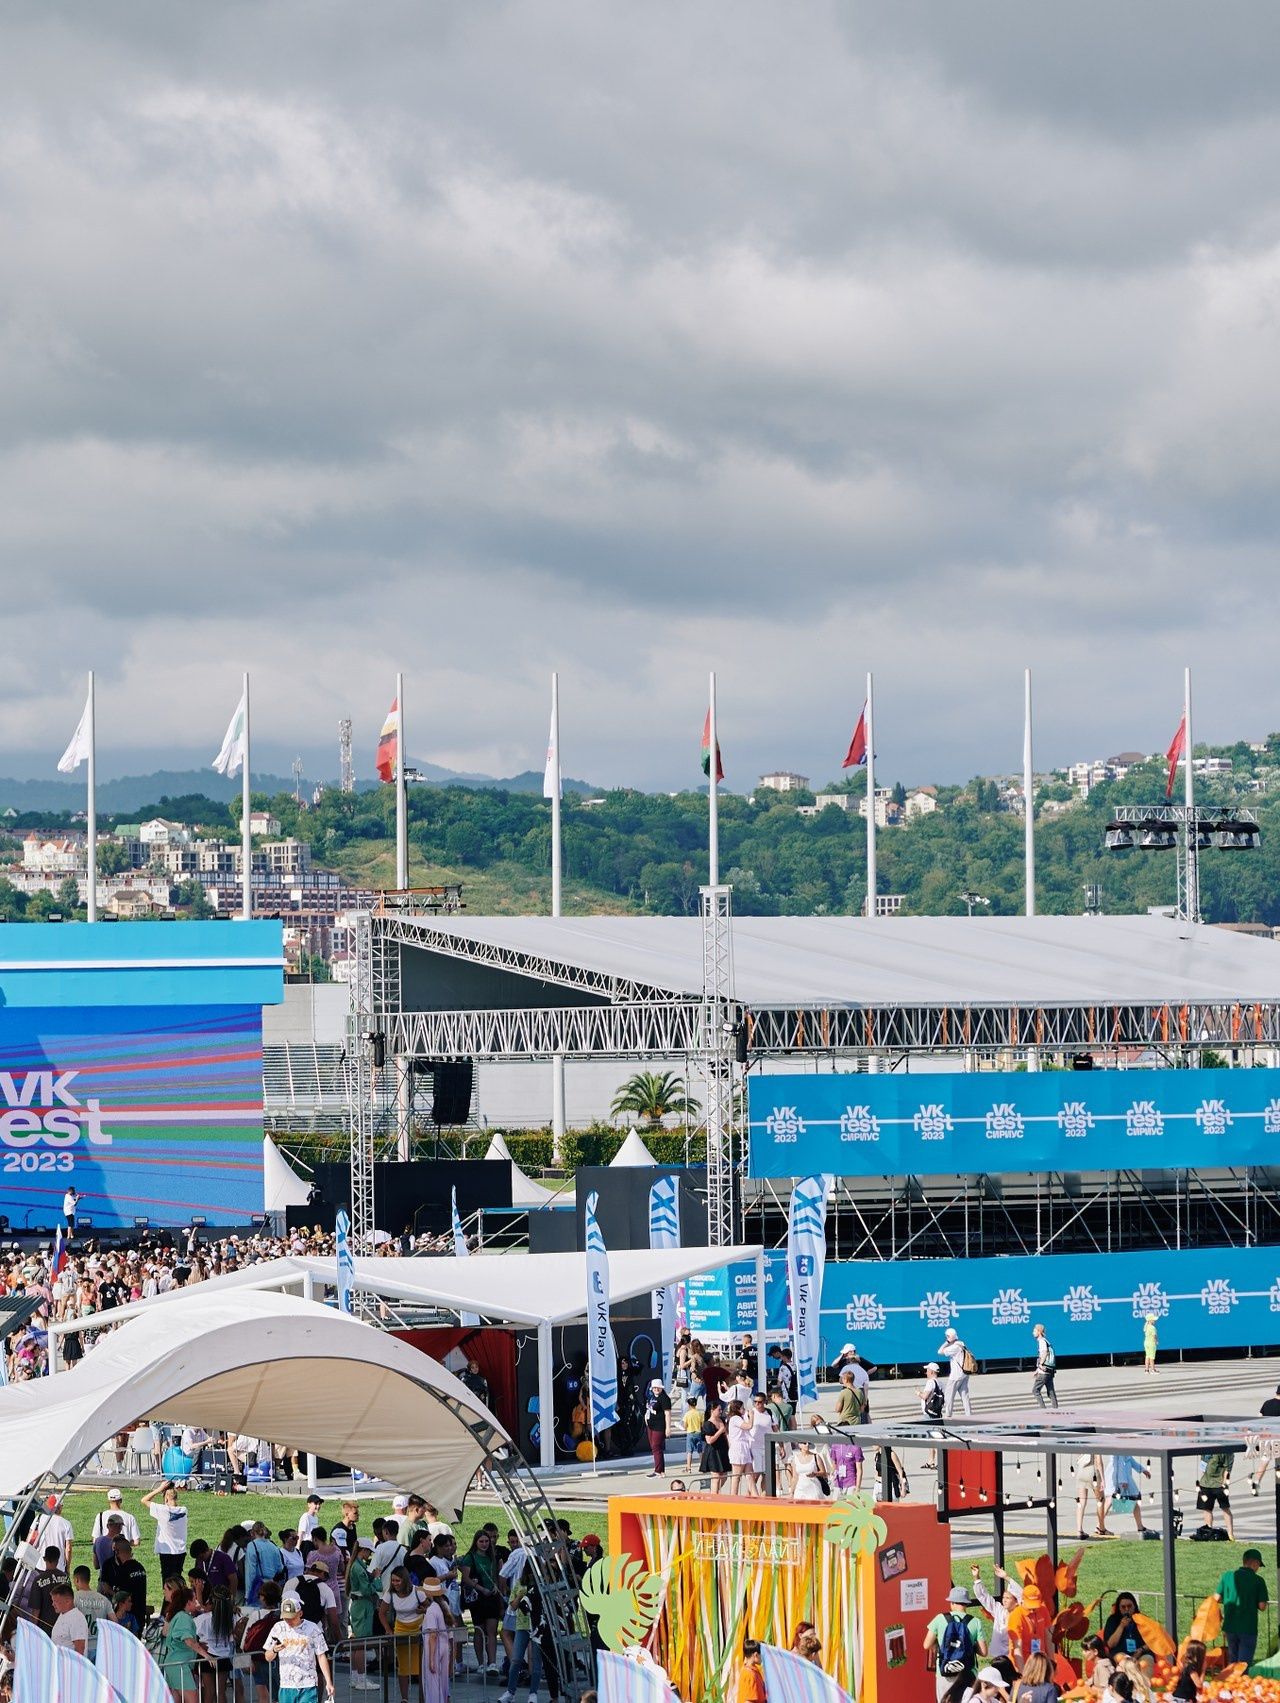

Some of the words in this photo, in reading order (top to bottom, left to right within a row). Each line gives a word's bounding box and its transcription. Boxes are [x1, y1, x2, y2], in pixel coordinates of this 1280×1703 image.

[772, 1106, 797, 1119] VK
[846, 1105, 871, 1118] VK
[920, 1104, 945, 1117] VK
[992, 1103, 1016, 1116] VK
[1064, 1102, 1086, 1115] VK
[1132, 1101, 1156, 1114] VK
[1202, 1100, 1225, 1113] VK
[840, 1114, 880, 1132] fest
[914, 1113, 954, 1131] fest
[986, 1112, 1024, 1130] fest
[1057, 1110, 1095, 1128] fest
[1126, 1109, 1164, 1127] fest
[1195, 1107, 1233, 1126] fest
[766, 1115, 806, 1134] fest
[1203, 1125, 1226, 1135] 2023
[840, 1132, 880, 1142] СИРИУС
[921, 1131, 945, 1140] 2023
[985, 1130, 1024, 1139] СИРИУС
[1065, 1128, 1087, 1137] 2023
[1126, 1127, 1164, 1136] СИРИУС
[774, 1134, 797, 1143] 2023
[3, 1151, 75, 1173] 2023
[1069, 1285, 1093, 1298] VK
[1138, 1282, 1161, 1295] VK
[1207, 1279, 1230, 1292] VK
[798, 1283, 808, 1303] VK
[926, 1291, 950, 1305] VK
[998, 1288, 1023, 1302] VK
[1201, 1287, 1239, 1306] fest
[736, 1301, 758, 1311] АВИТ
[852, 1293, 877, 1307] VK
[992, 1297, 1031, 1316] fest
[1063, 1294, 1101, 1313] fest
[1132, 1291, 1170, 1309] fest
[596, 1301, 607, 1322] VK
[846, 1303, 886, 1321] fest
[920, 1300, 959, 1319] fest
[1208, 1305, 1230, 1315] 2023
[992, 1315, 1030, 1325] СИРИУС
[1070, 1312, 1092, 1321] 2023
[846, 1321, 885, 1331] СИРИУС
[927, 1319, 950, 1328] 2023
[595, 1326, 608, 1358] Play
